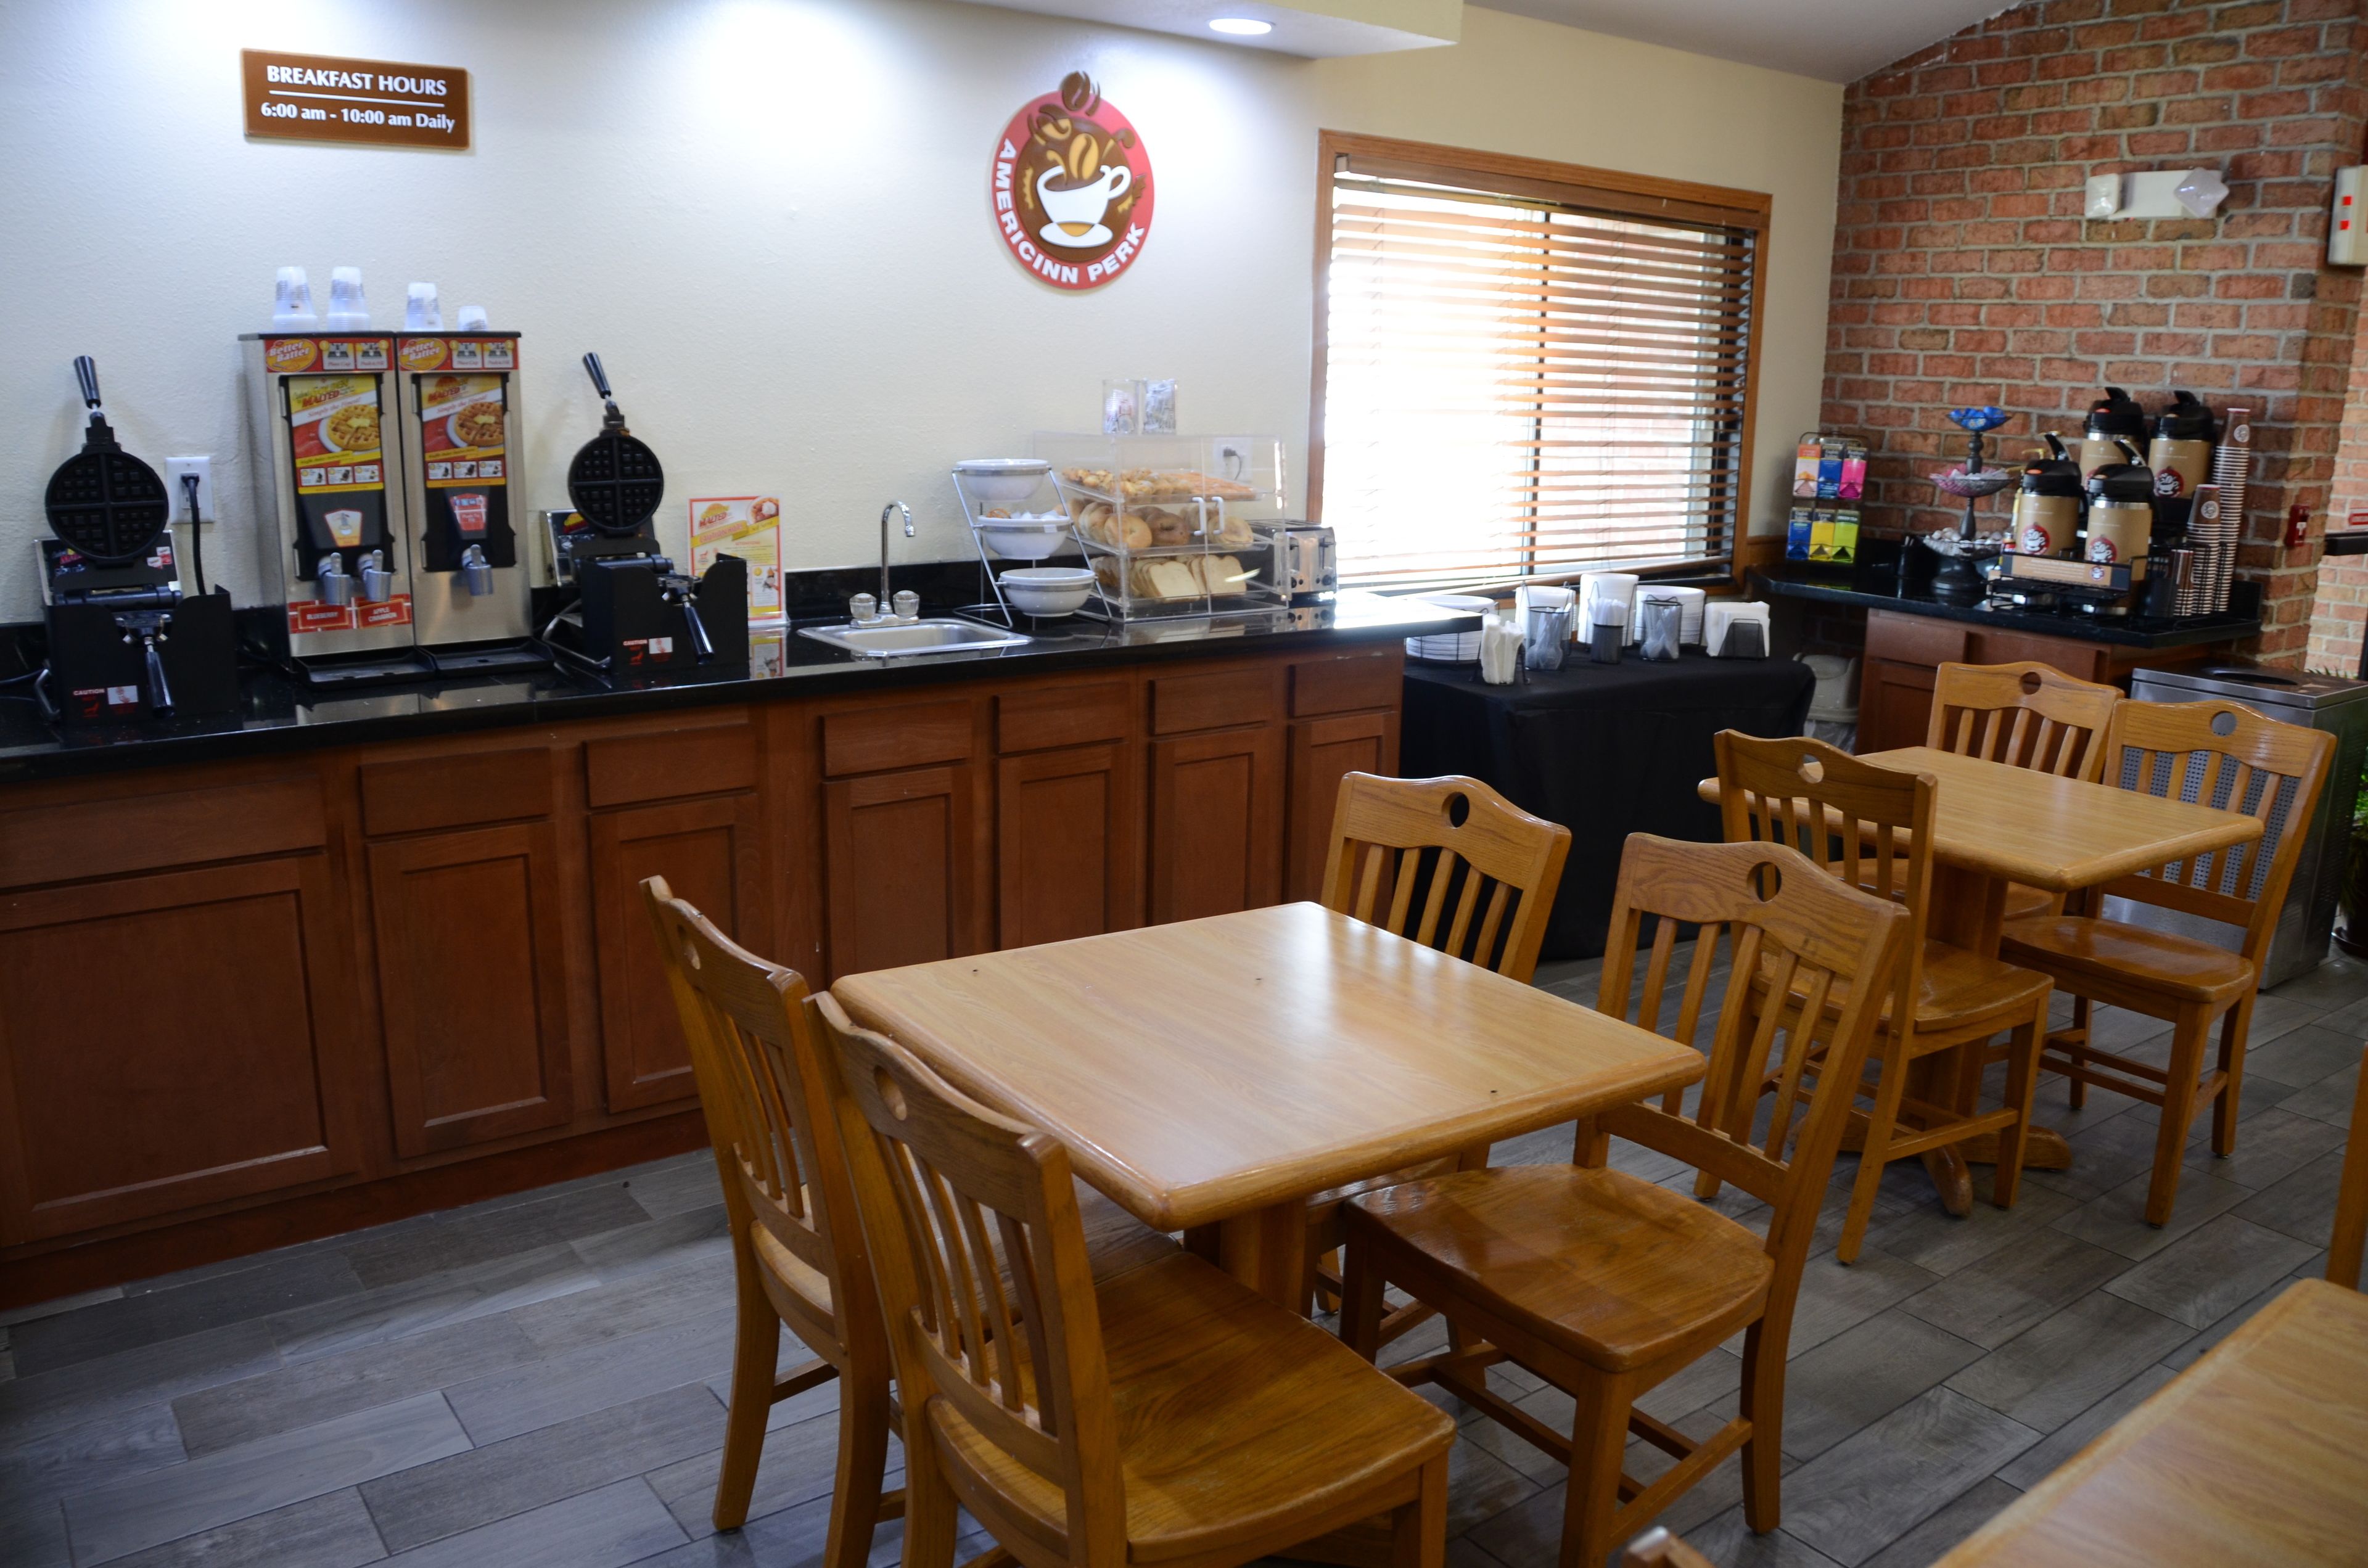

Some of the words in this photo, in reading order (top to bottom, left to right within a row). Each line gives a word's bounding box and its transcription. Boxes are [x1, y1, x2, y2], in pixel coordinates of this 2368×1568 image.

[266, 65, 373, 90] BREAKFAST
[378, 75, 447, 96] HOURS
[260, 102, 298, 118] 6:00
[300, 106, 326, 121] am
[340, 108, 385, 125] 10:00
[387, 113, 412, 126] am
[415, 113, 455, 133] Daily
[995, 138, 1079, 284] AMERICINN
[1087, 222, 1145, 282] PERK
[269, 342, 303, 356] Better
[277, 347, 310, 362] Batter
[403, 341, 435, 355] Better
[409, 347, 440, 361] Batter
[306, 611, 339, 620] BLUEBERRY
[368, 612, 397, 622] CINNAMON
